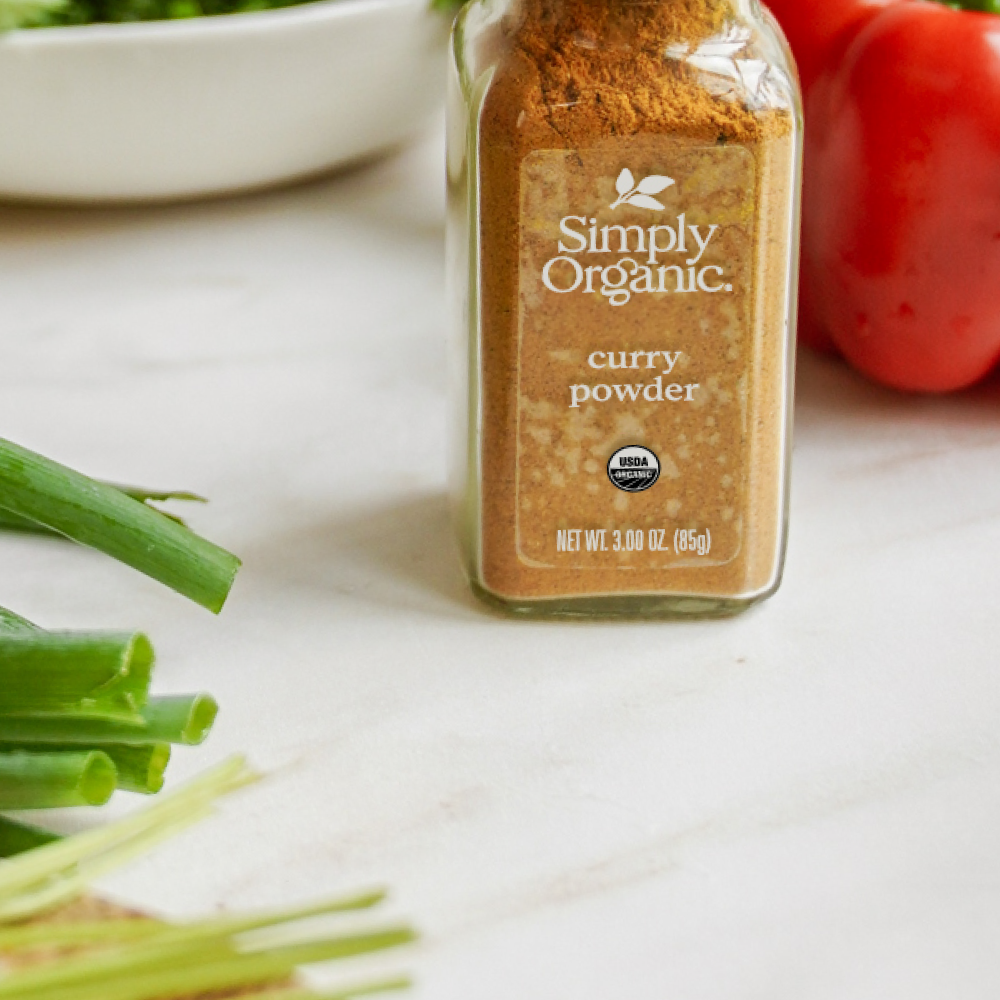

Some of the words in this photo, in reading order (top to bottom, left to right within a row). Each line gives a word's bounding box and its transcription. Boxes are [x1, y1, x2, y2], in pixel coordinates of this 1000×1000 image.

[557, 212, 719, 265] Simply
[587, 348, 682, 374] curry
[568, 376, 700, 408] powder
[619, 456, 649, 467] USDA
[556, 529, 582, 552] NET
[584, 529, 608, 552] WT.
[612, 529, 644, 552] 3.00
[648, 529, 669, 552] OZ.
[673, 528, 711, 556] (85g)
